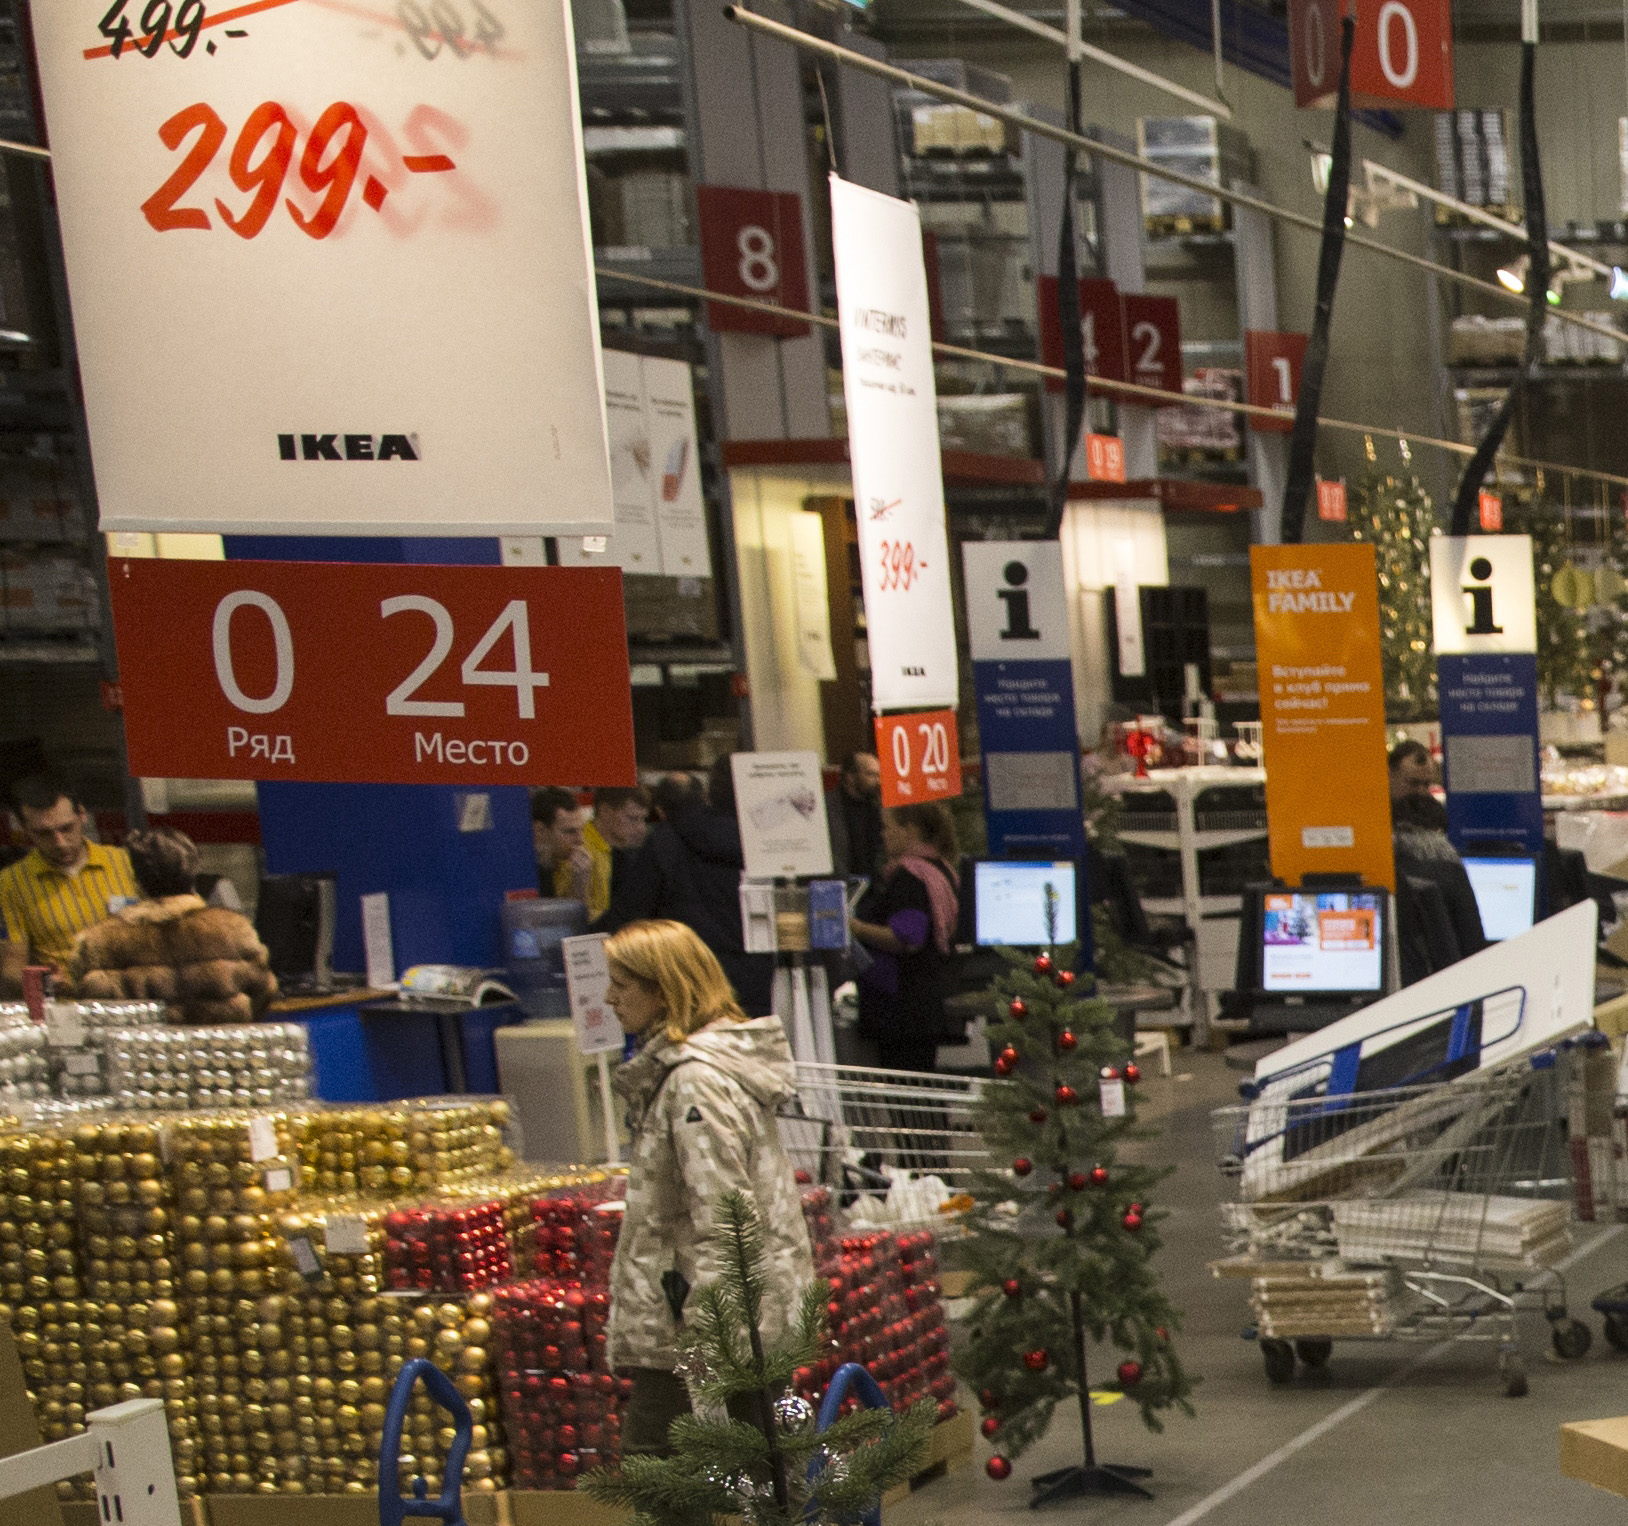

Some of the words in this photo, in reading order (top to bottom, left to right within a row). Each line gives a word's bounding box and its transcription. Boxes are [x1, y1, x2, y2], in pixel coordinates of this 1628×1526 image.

[1376, 0, 1419, 89] 0
[140, 100, 456, 240] 299.-
[738, 225, 781, 293] 8
[1132, 320, 1165, 372] 2
[1271, 356, 1293, 402] 1
[278, 433, 419, 462] IKEA
[879, 540, 929, 592] 399.-
[1266, 569, 1321, 588] IKEA
[1267, 591, 1357, 614] FAMILY
[211, 588, 296, 715] 0
[379, 594, 551, 719] 24
[226, 726, 296, 766] Ряд
[414, 731, 531, 767] Место
[891, 726, 910, 778] 0
[920, 722, 949, 775] 20
